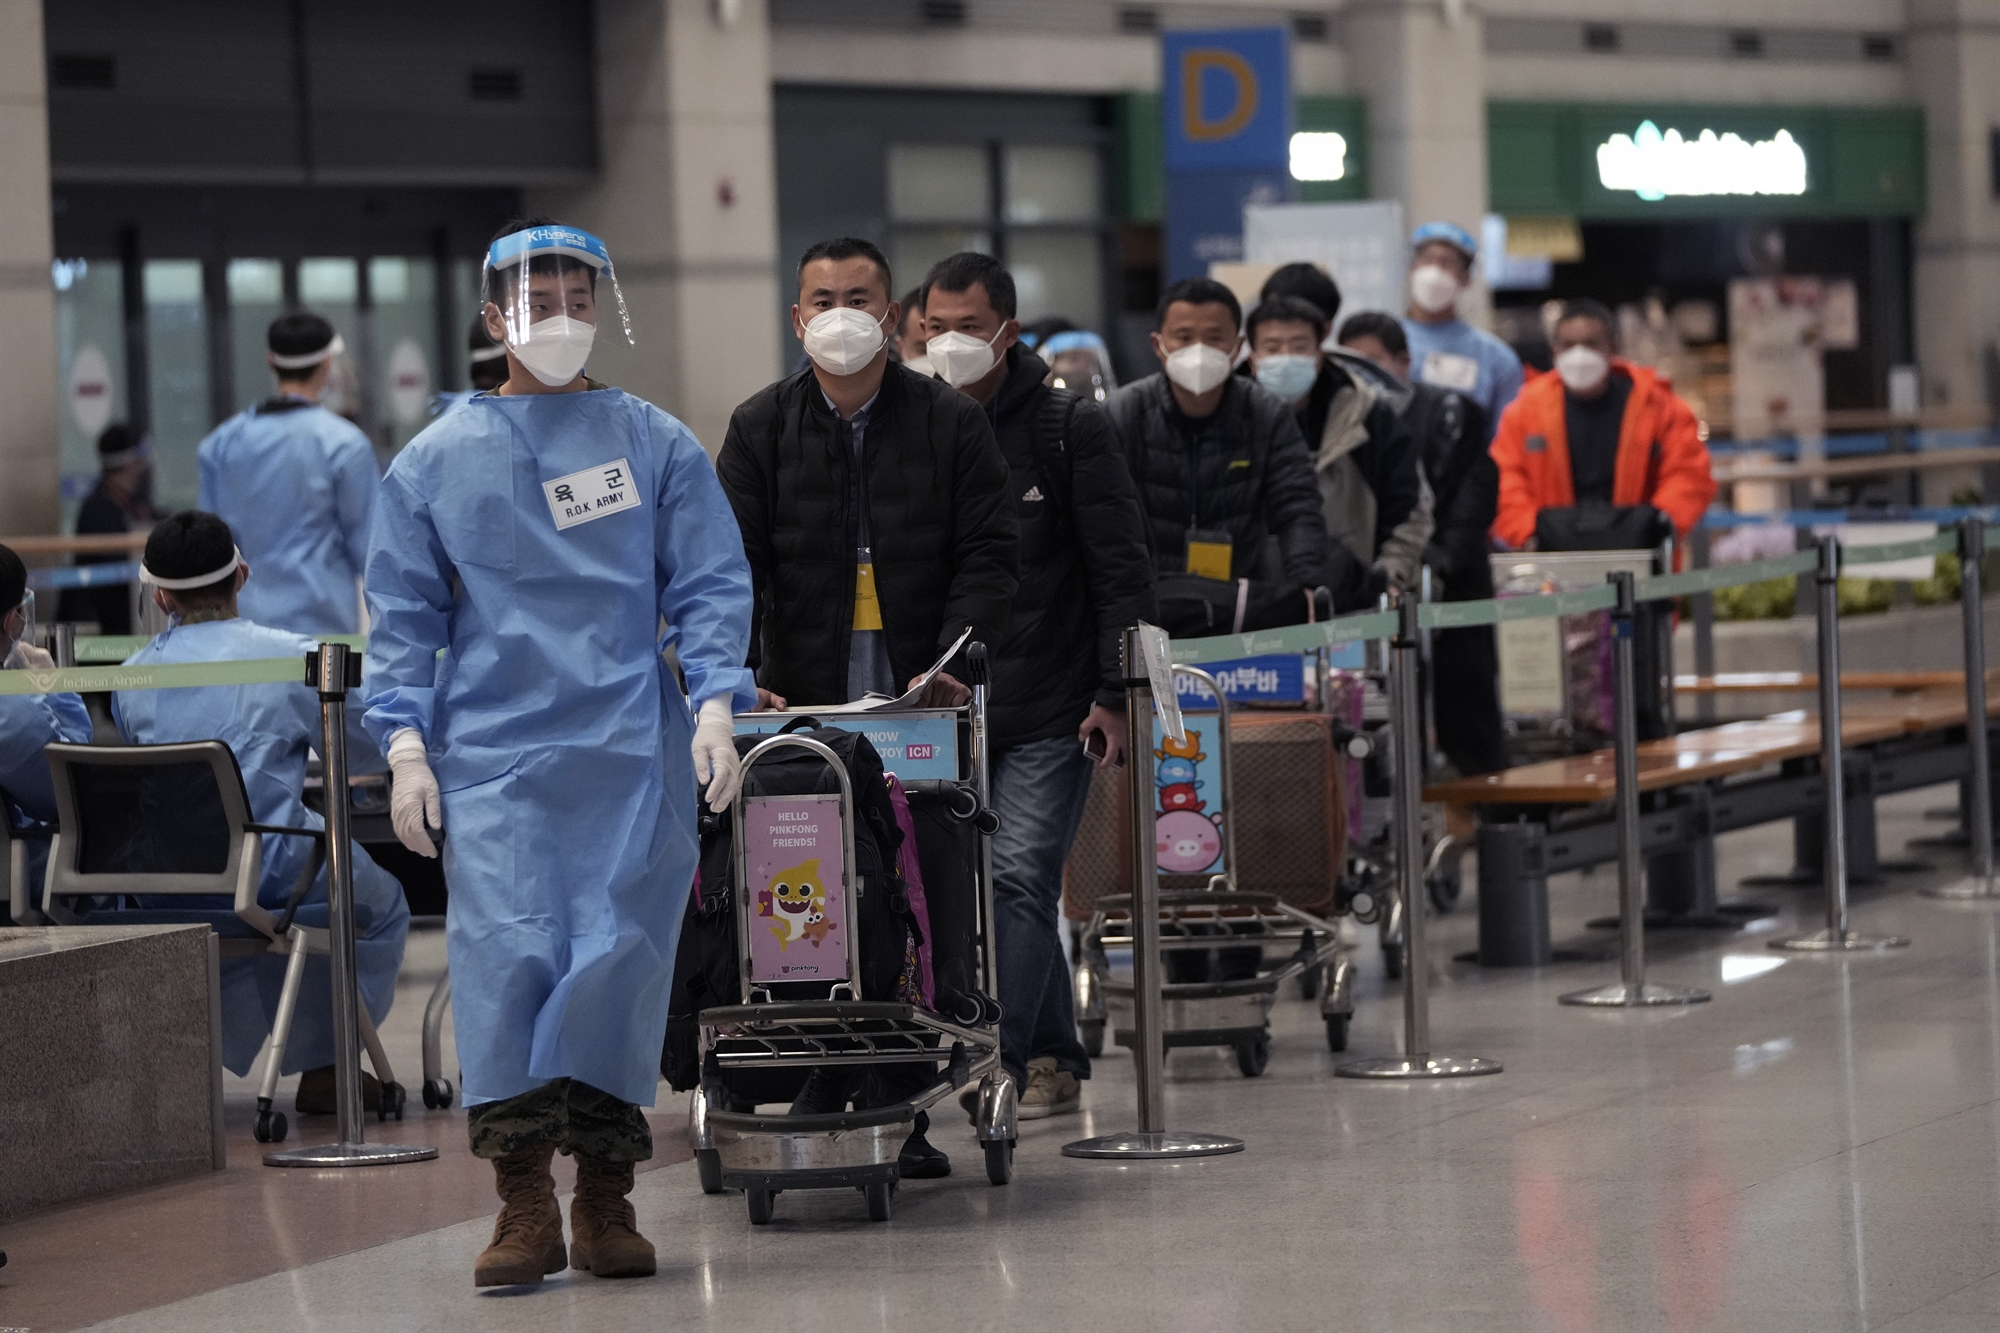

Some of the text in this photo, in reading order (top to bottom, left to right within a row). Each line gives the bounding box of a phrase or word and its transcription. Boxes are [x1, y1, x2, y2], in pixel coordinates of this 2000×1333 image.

[1181, 49, 1259, 142] D
[604, 468, 624, 489] 군
[566, 491, 623, 518] R.O.K ARMY
[63, 674, 153, 689] Incheon Airport
[876, 748, 903, 758] JOY
[909, 747, 930, 757] ICN
[778, 812, 808, 821] HELLO
[770, 825, 818, 834] PINKFONG
[773, 838, 816, 847] FRIENDS!
[791, 965, 818, 974] pinkfong
